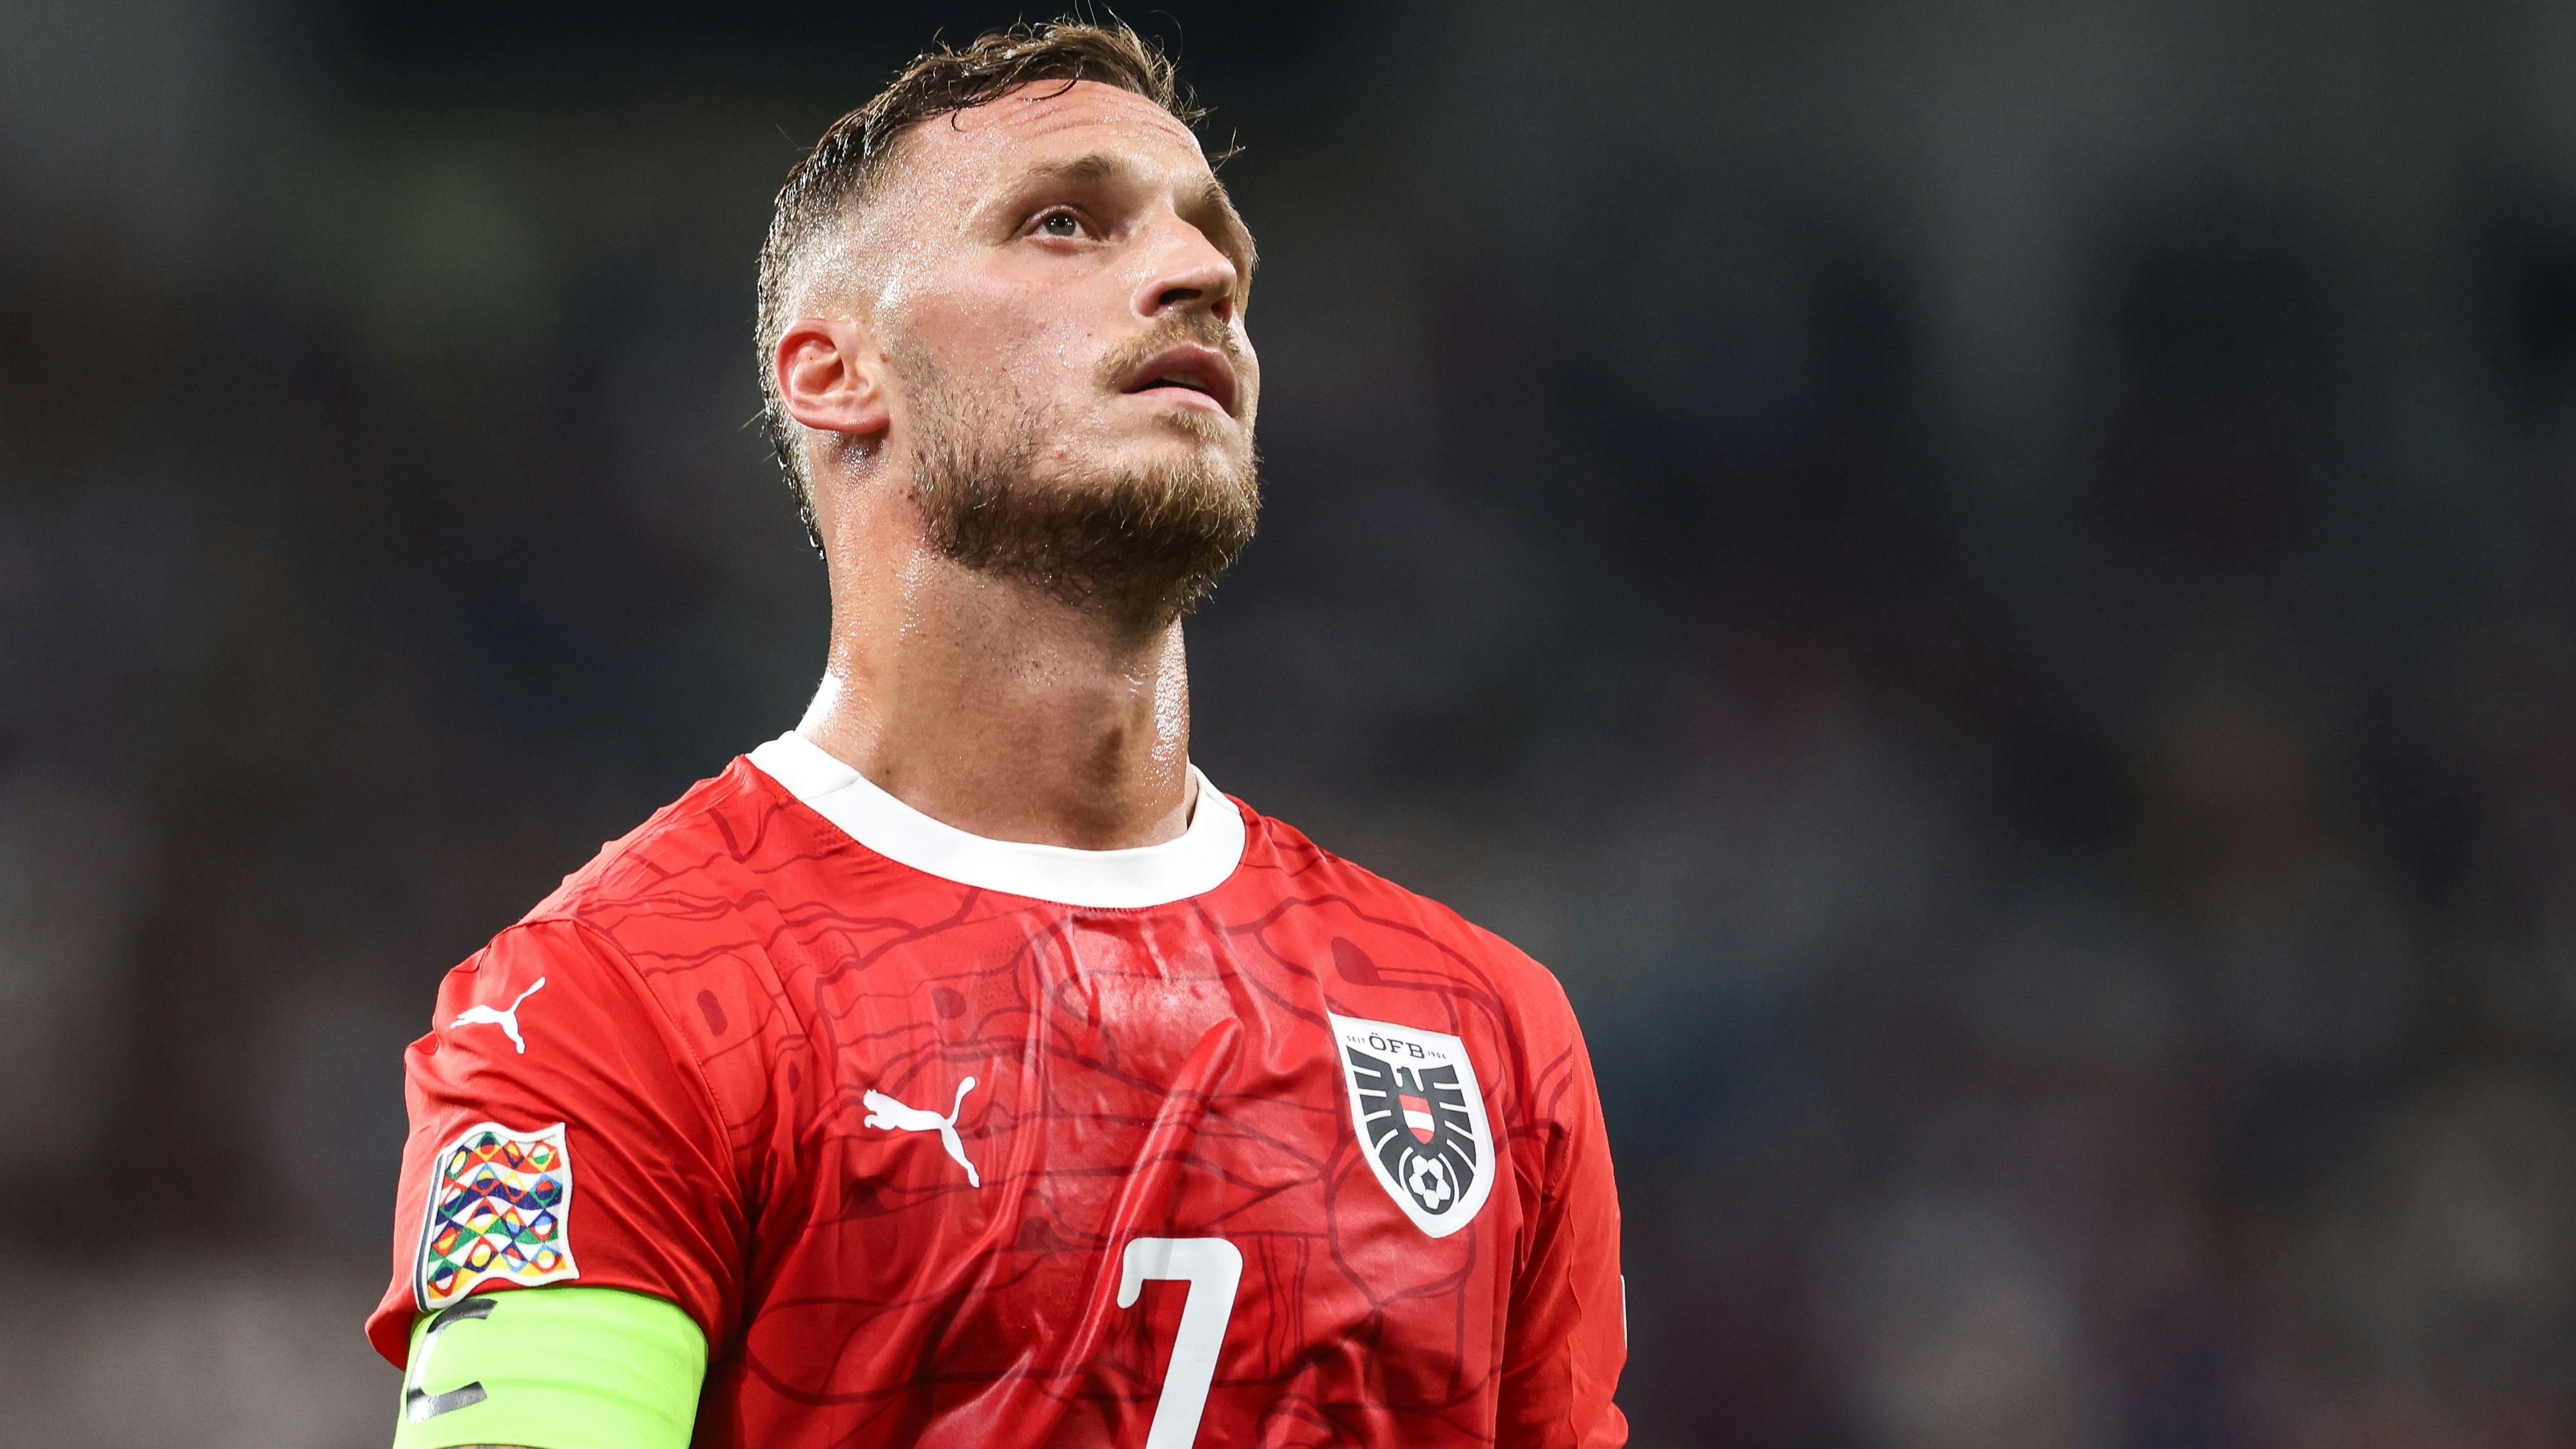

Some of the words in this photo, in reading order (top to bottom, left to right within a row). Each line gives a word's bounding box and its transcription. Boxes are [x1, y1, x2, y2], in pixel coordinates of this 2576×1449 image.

[1347, 1035, 1365, 1044] SEIT
[1368, 1032, 1425, 1059] ÖFB
[1427, 1050, 1447, 1059] 1904
[1117, 1237, 1244, 1449] 7
